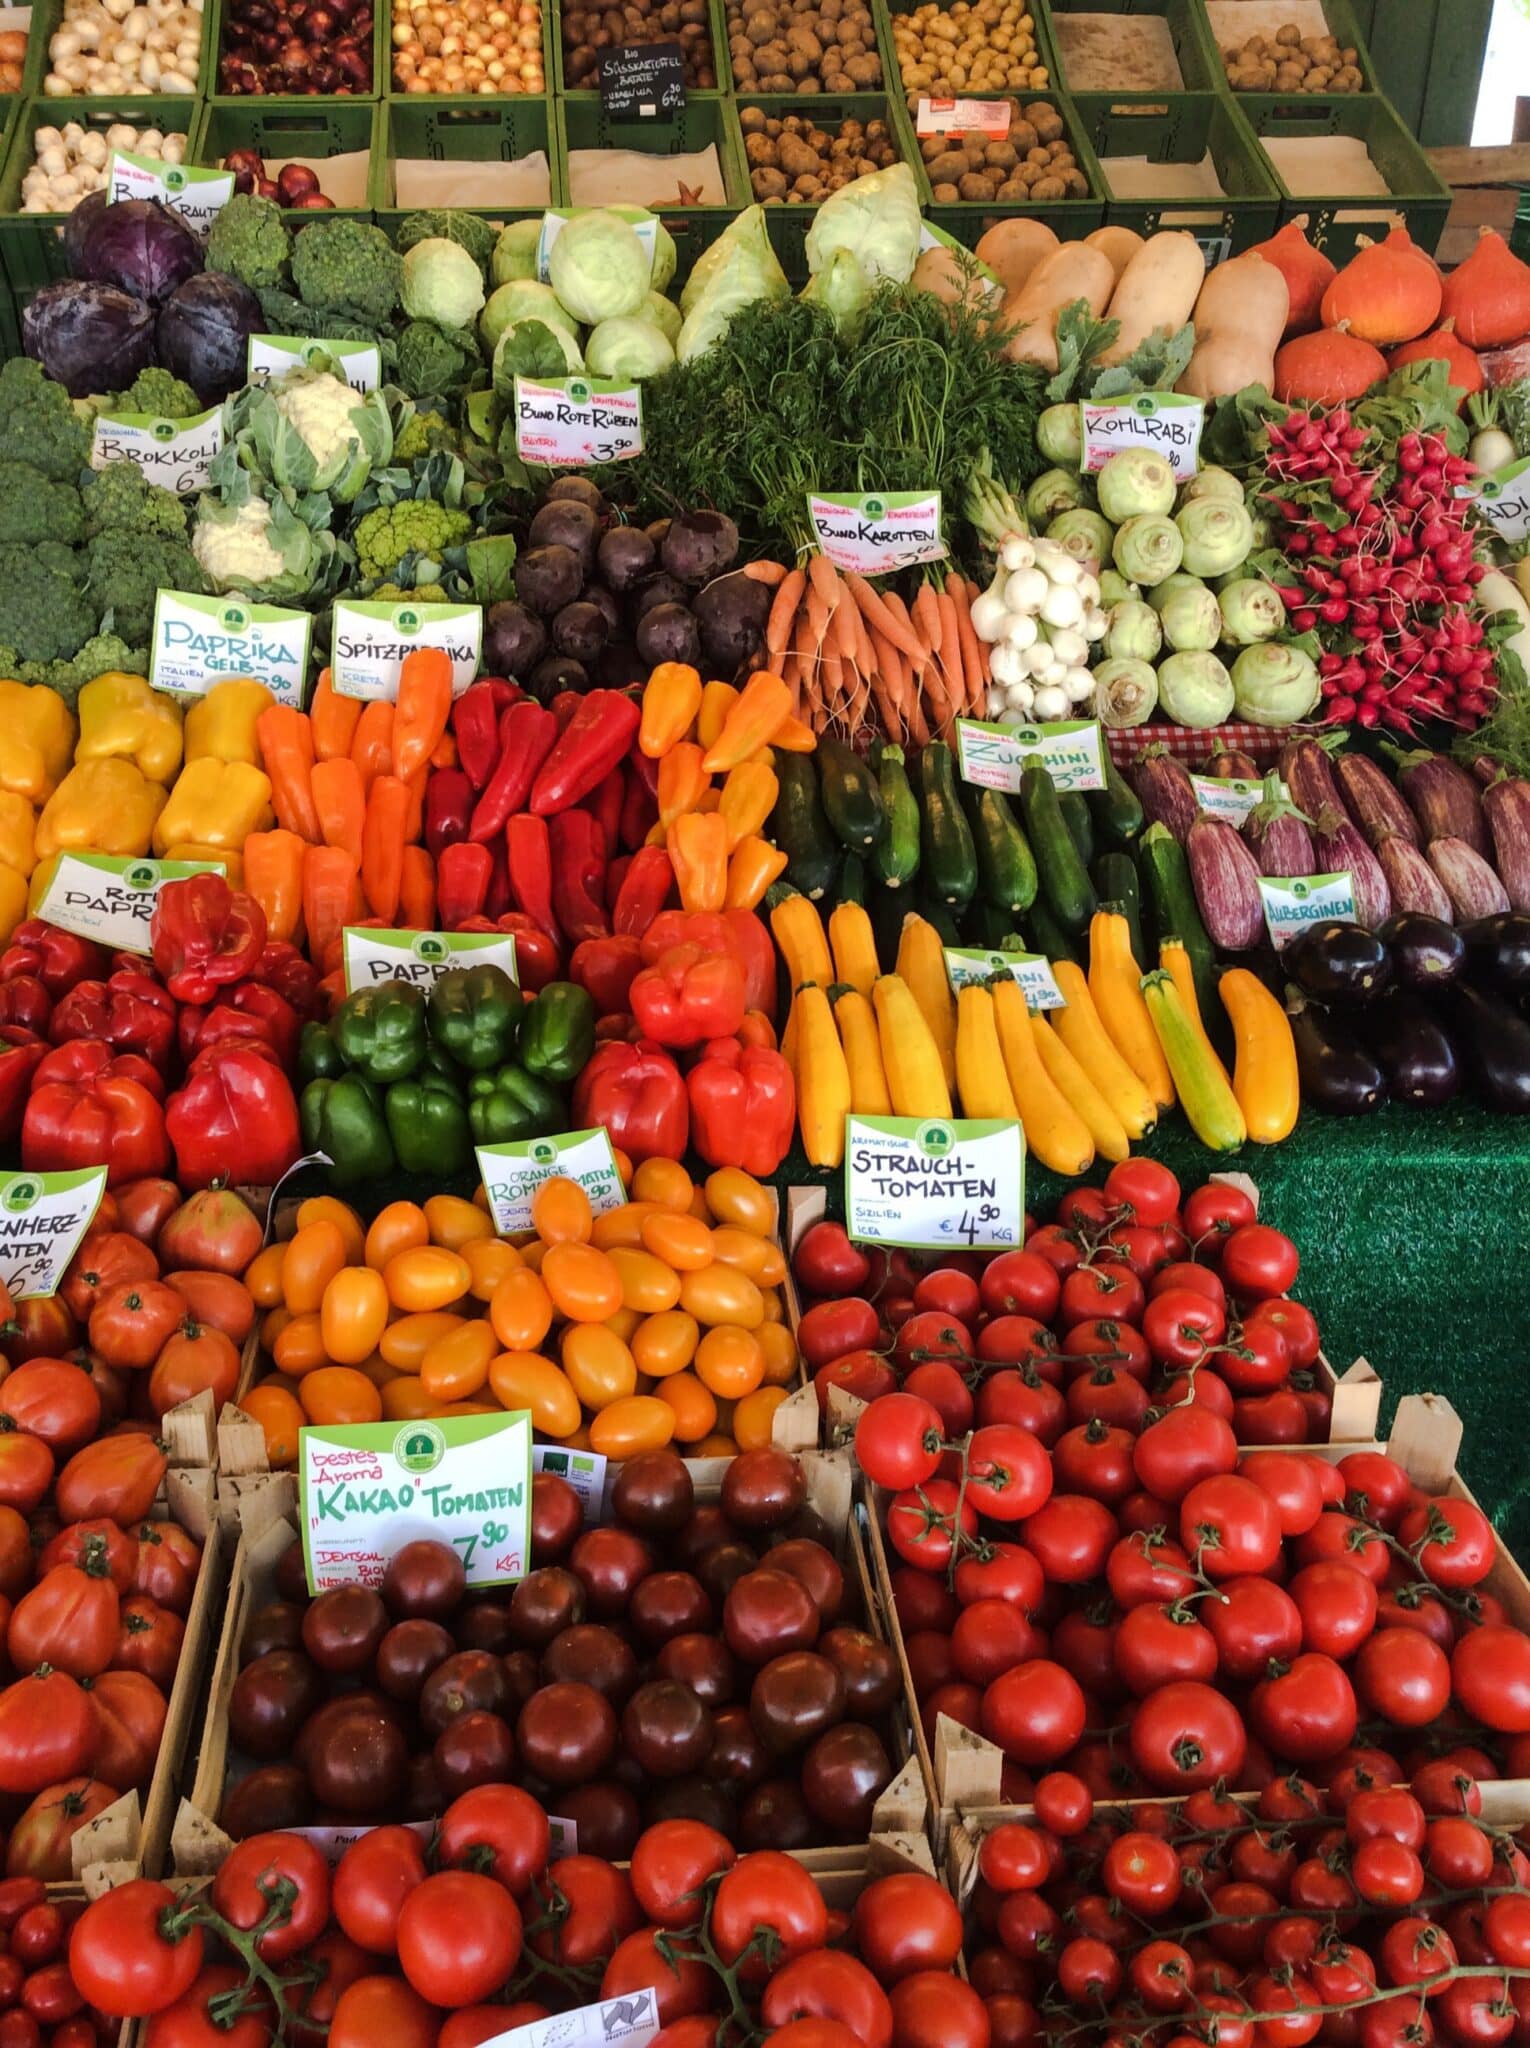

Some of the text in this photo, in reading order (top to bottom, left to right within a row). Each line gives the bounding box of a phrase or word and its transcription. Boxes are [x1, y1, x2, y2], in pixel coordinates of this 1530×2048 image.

[556, 403, 592, 426] ROTE
[591, 408, 638, 429] RÜBEN
[1086, 417, 1196, 445] KOHLRABI
[96, 432, 218, 466] BROKKOLI
[1477, 495, 1529, 519] ADI
[162, 619, 298, 665] PAPRIKA
[160, 665, 205, 678] ITALIEN
[966, 739, 1090, 766] ZUCHINI
[106, 887, 157, 902] ROT
[510, 1165, 569, 1183] ORANGE
[852, 1150, 975, 1176] STRAUCH-
[871, 1177, 997, 1199] TOMATEN
[855, 1206, 902, 1219] SIZILIEN
[991, 1227, 1013, 1241] KG
[311, 1450, 379, 1467] bestes
[311, 1466, 383, 1485] Aroma
[421, 1482, 524, 1518] TOMATEN
[495, 1552, 520, 1572] KG
